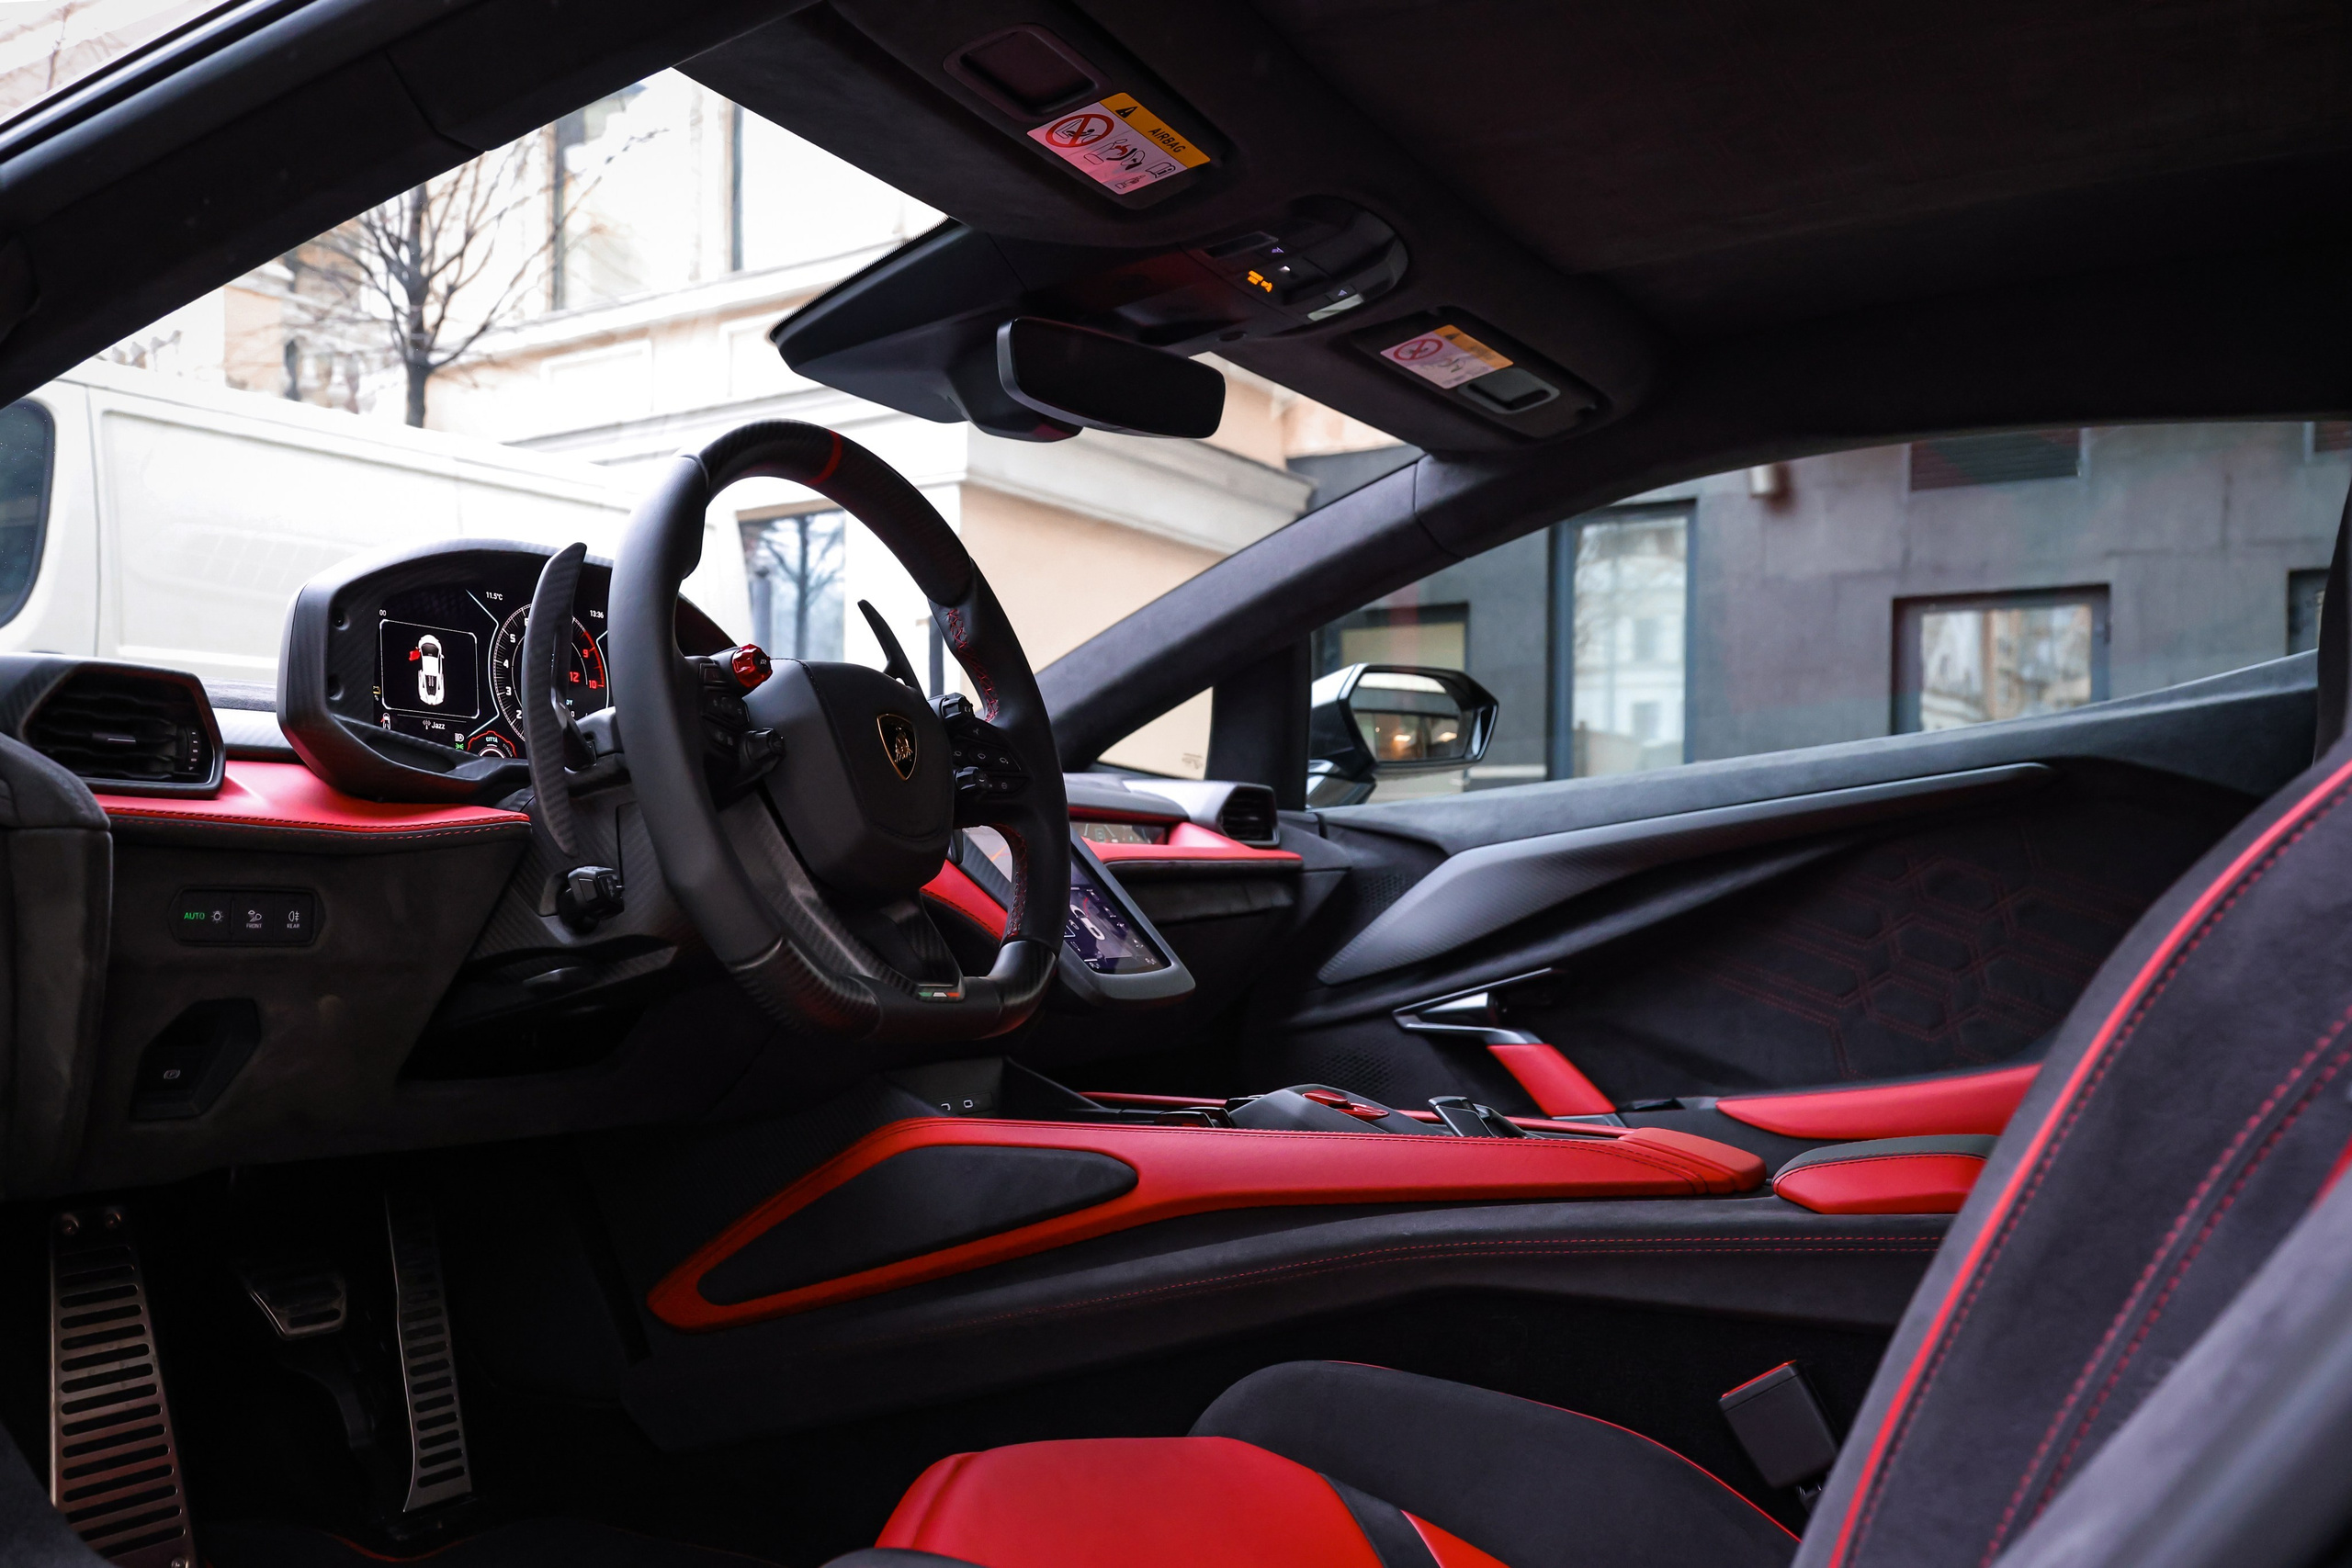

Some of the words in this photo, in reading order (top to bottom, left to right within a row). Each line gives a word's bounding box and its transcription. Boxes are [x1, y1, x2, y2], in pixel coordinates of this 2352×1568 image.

[1148, 128, 1186, 153] AIRBAG
[485, 591, 503, 601] 11.5°C
[589, 609, 605, 619] 13:36
[509, 634, 516, 643] 5
[582, 649, 589, 658] 9
[503, 659, 509, 669] 4
[570, 671, 580, 682] 12
[589, 680, 597, 689] 10
[505, 686, 512, 695] 3
[515, 709, 522, 719] 2
[431, 721, 446, 730] Jazz
